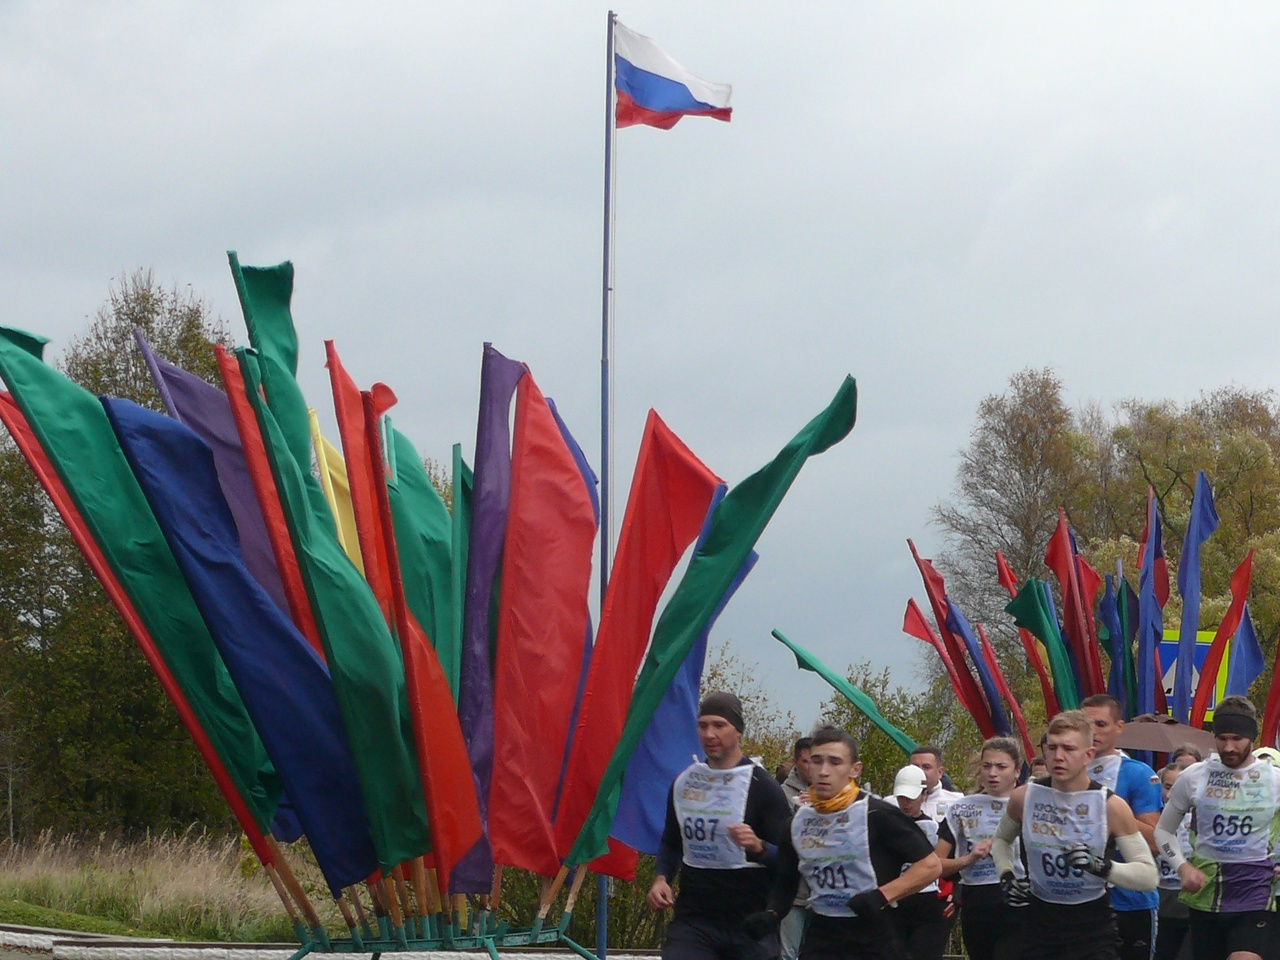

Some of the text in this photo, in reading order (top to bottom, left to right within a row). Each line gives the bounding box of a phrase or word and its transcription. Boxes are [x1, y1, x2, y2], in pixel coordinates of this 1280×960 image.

[1209, 771, 1234, 780] КРОСС
[1207, 779, 1240, 788] НАЦИИ
[1206, 788, 1237, 799] 2021
[951, 803, 976, 811] КРОСС
[952, 810, 982, 819] НАЦИИ
[683, 817, 719, 841] 687
[1213, 814, 1253, 836] 656
